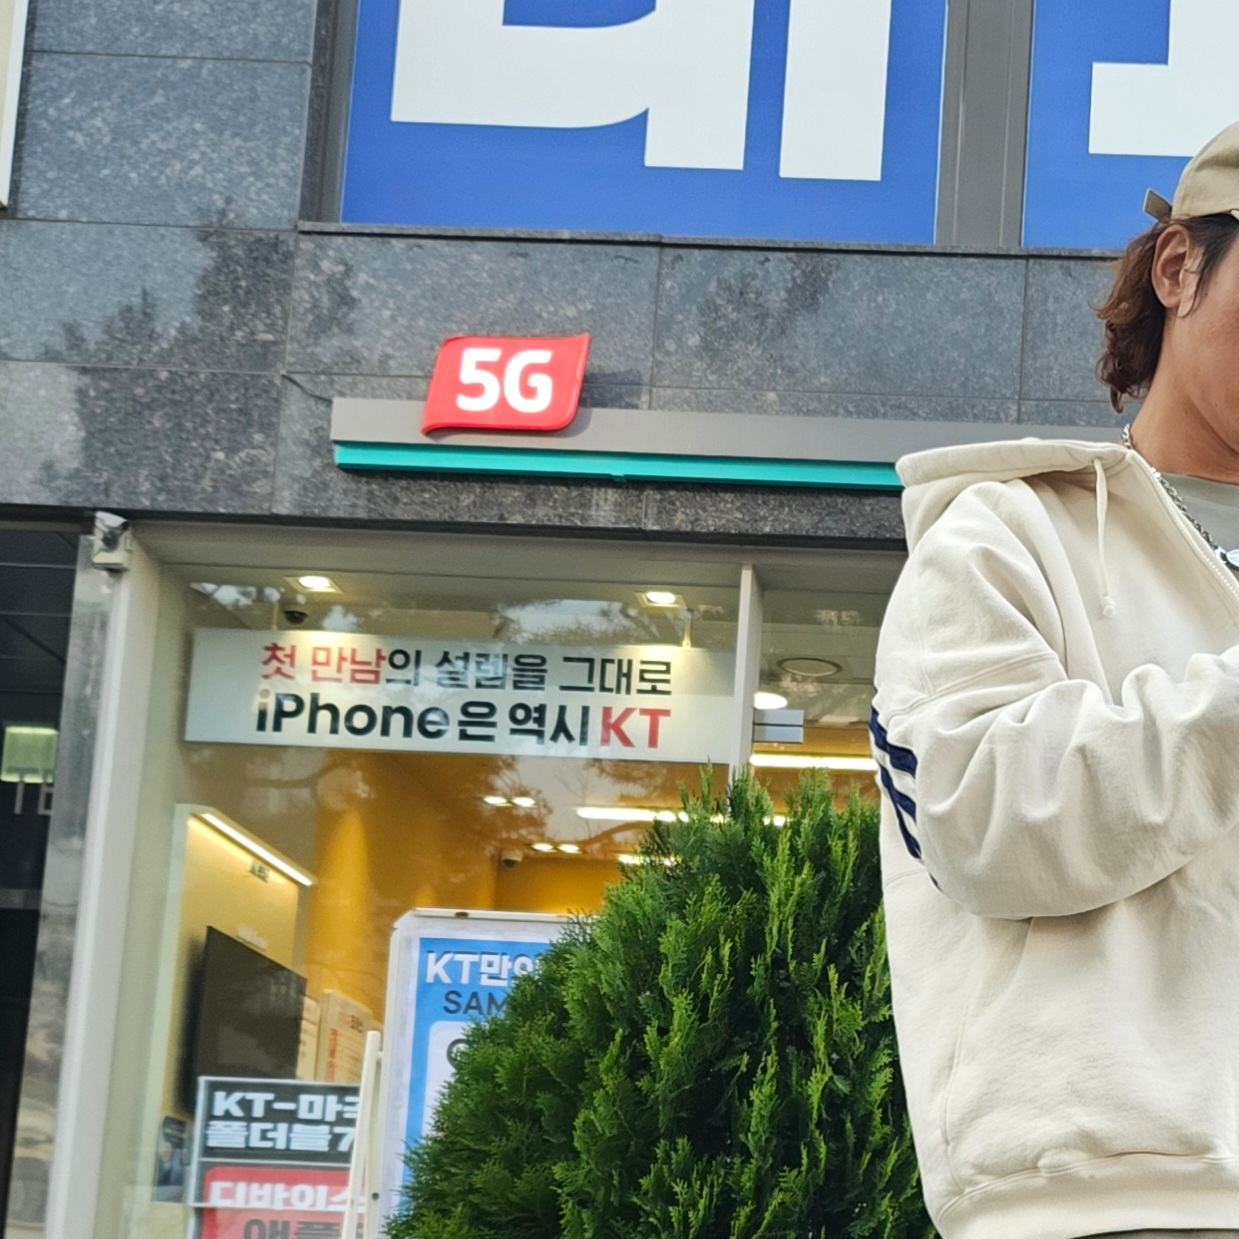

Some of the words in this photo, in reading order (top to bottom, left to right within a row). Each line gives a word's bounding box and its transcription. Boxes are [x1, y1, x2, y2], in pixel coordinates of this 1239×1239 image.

[456, 347, 554, 413] 5G
[262, 642, 297, 680] 첫
[311, 646, 422, 687] 만남의
[559, 656, 672, 695] 그대로
